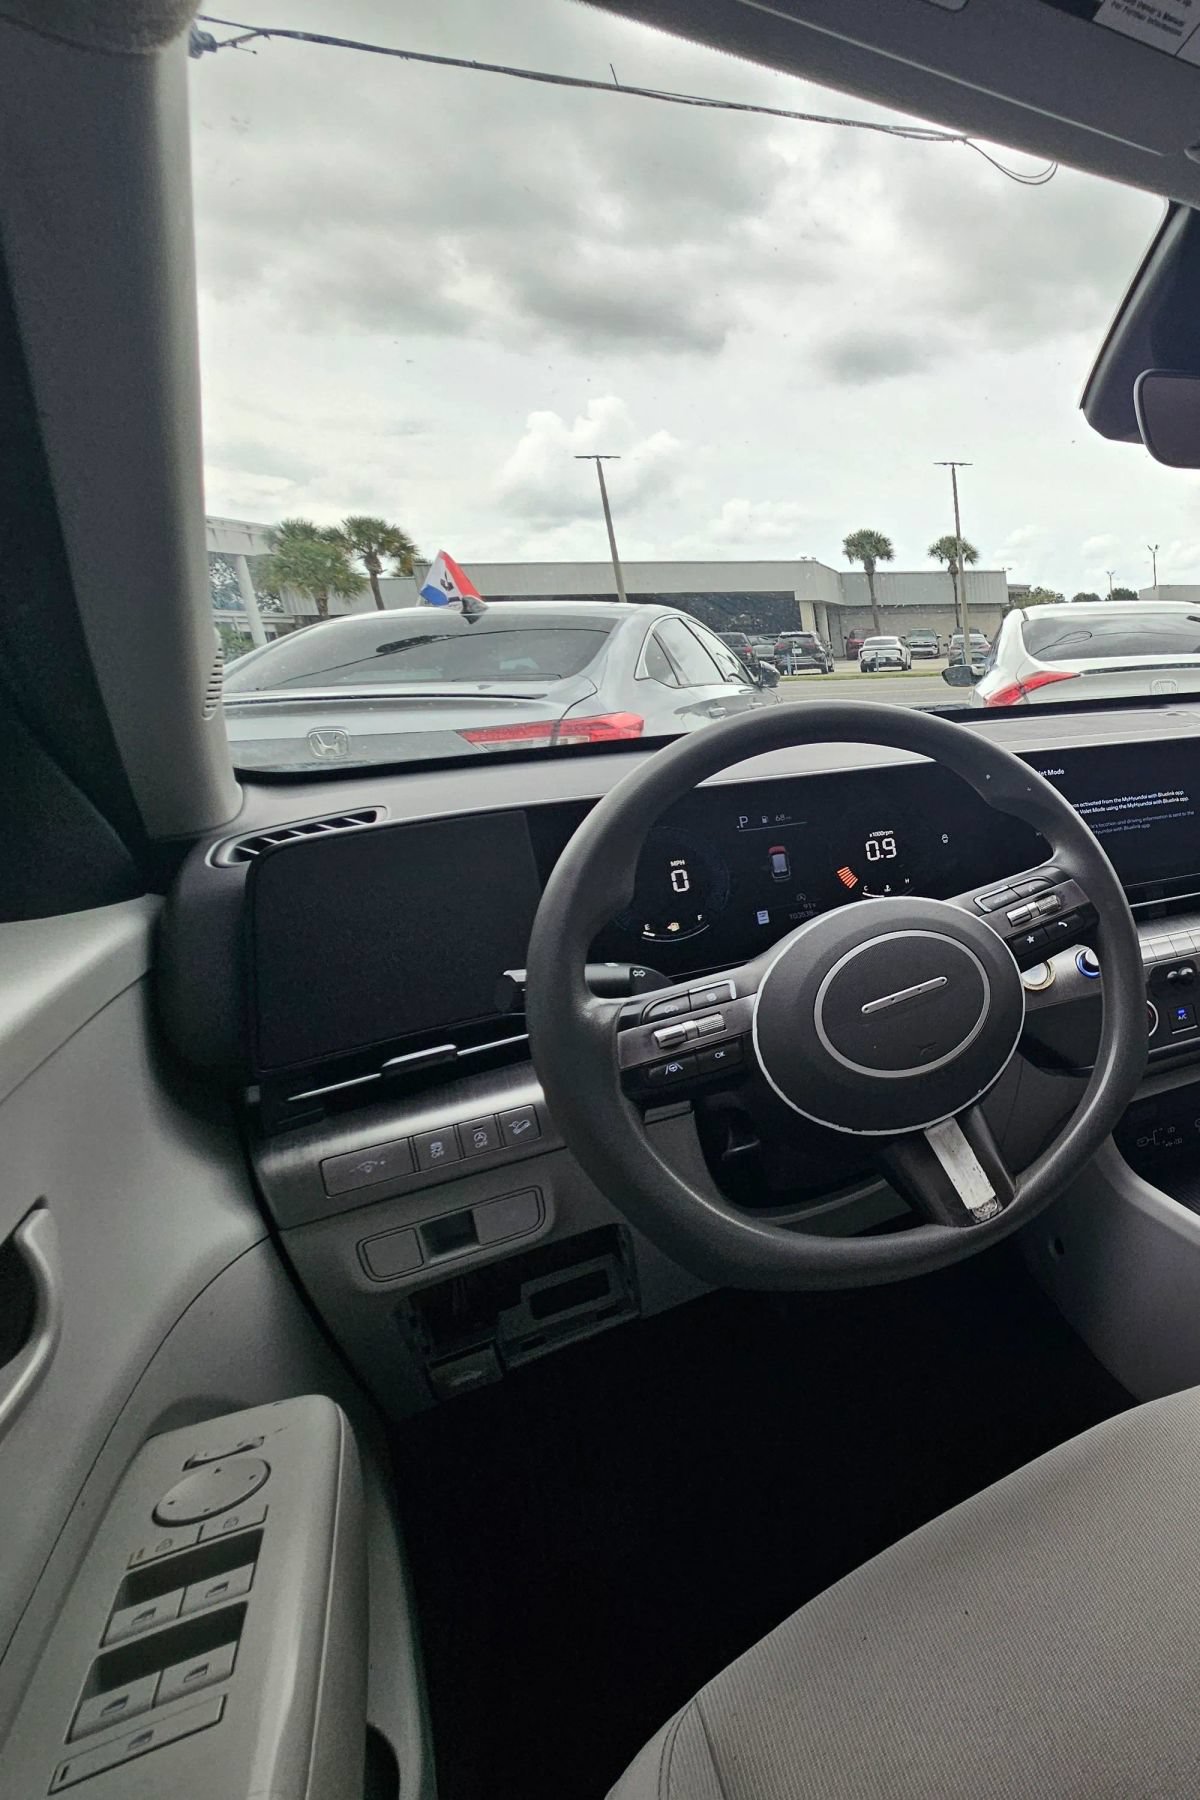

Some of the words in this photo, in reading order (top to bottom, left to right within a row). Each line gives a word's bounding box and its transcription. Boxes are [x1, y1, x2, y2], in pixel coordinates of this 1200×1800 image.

[1048, 768, 1065, 776] Mode
[739, 815, 749, 828] P
[865, 837, 897, 861] 0.9
[670, 859, 686, 867] MPH
[670, 869, 690, 892] 0
[714, 1051, 726, 1059] OK
